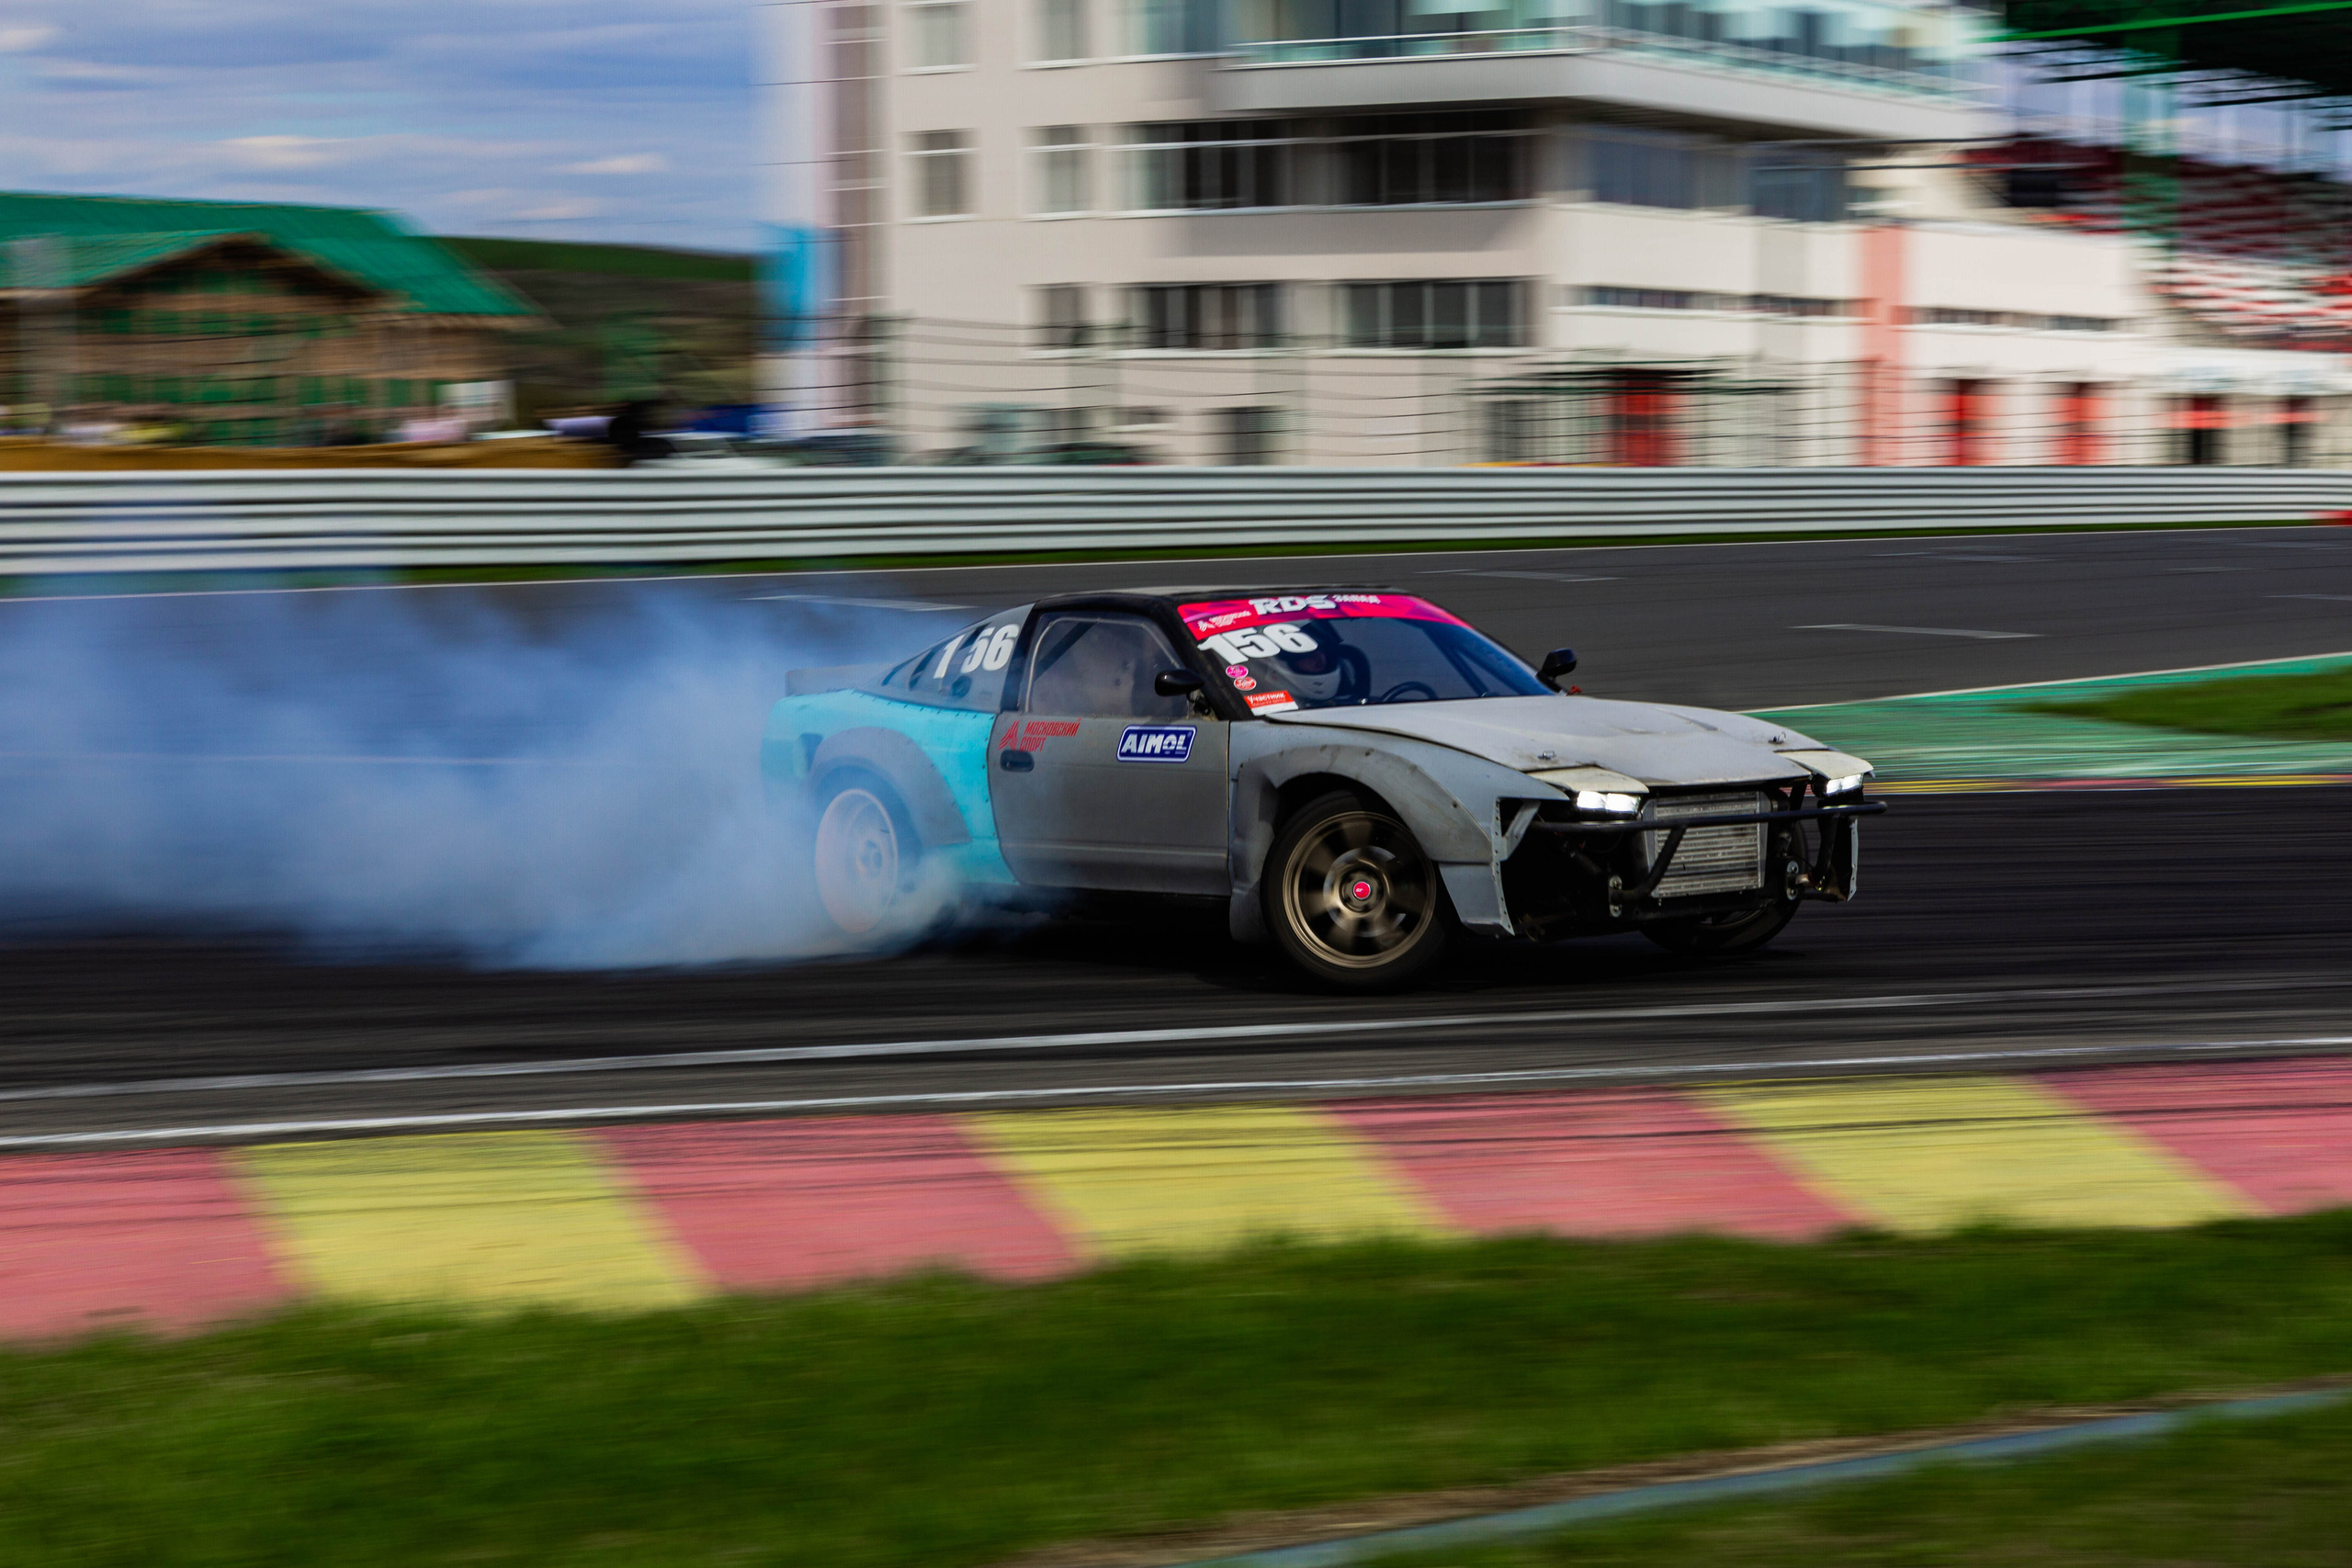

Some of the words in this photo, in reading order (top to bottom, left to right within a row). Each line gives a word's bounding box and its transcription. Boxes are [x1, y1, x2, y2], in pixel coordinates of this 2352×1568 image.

[1249, 594, 1337, 615] RDS
[933, 624, 1020, 679] 156
[1197, 623, 1318, 665] 156
[1023, 717, 1081, 738] МОСКОВСКИЙ
[1019, 736, 1047, 752] СПОРТ
[1121, 733, 1187, 754] AIMOL
